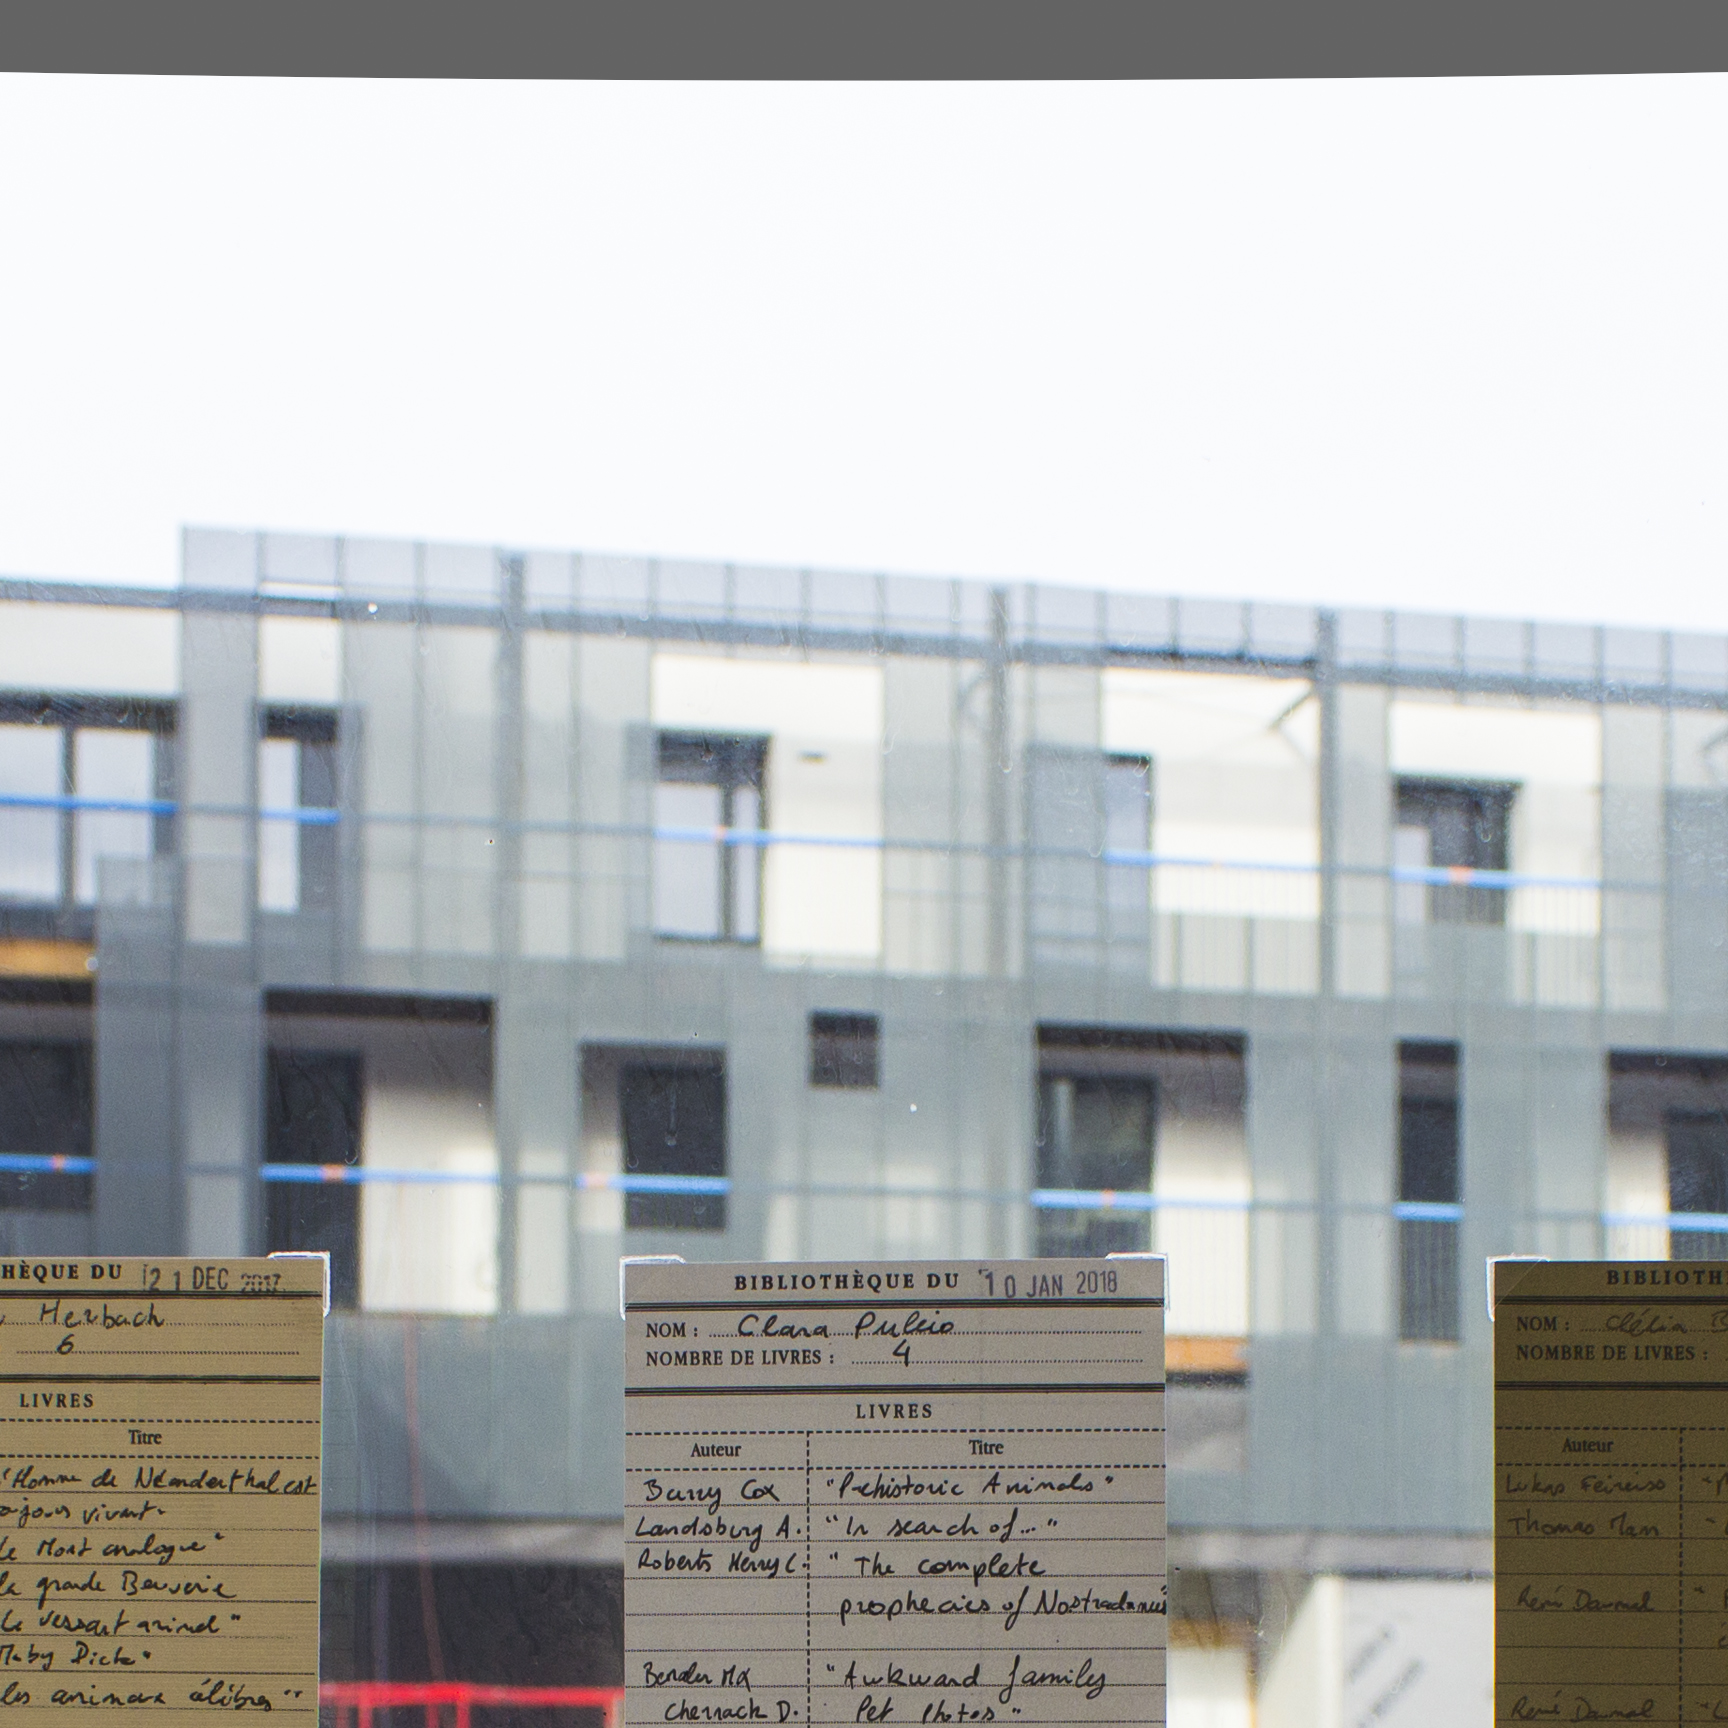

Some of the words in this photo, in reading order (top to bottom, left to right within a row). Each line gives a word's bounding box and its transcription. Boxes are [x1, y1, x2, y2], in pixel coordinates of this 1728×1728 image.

[90, 1265, 122, 1280] DU
[192, 1266, 228, 1290] DEC
[735, 1269, 915, 1292] BIBLIOTHÈQUE
[927, 1273, 959, 1289] DU
[1025, 1277, 1064, 1297] JAN
[1075, 1270, 1118, 1295] 2018
[737, 1314, 829, 1338] Clara
[56, 1335, 74, 1356] 6
[646, 1350, 725, 1367] NOMBRE
[730, 1350, 755, 1366] DE
[762, 1349, 821, 1366] LIVRES
[892, 1339, 911, 1367] 4
[1517, 1345, 1595, 1361] NOMBRE
[1602, 1345, 1628, 1361] DE
[1634, 1345, 1695, 1361] LIVRES
[19, 1393, 94, 1408] LIVRES
[856, 1403, 933, 1419] LIVRES
[129, 1430, 162, 1446] Titre
[691, 1442, 741, 1457] Auteur
[970, 1439, 1004, 1455] Titre
[1562, 1438, 1613, 1453] Auteur
[92, 1468, 117, 1488] de
[740, 1479, 780, 1502] Cox
[776, 1514, 801, 1540] A.
[888, 1513, 978, 1537] search
[1508, 1509, 1595, 1536] Thomas
[918, 1554, 1045, 1584] complete
[1003, 1587, 1030, 1631] of
[999, 1655, 1106, 1703] family
[776, 1700, 799, 1723] D.
[855, 1702, 894, 1723] Pet
